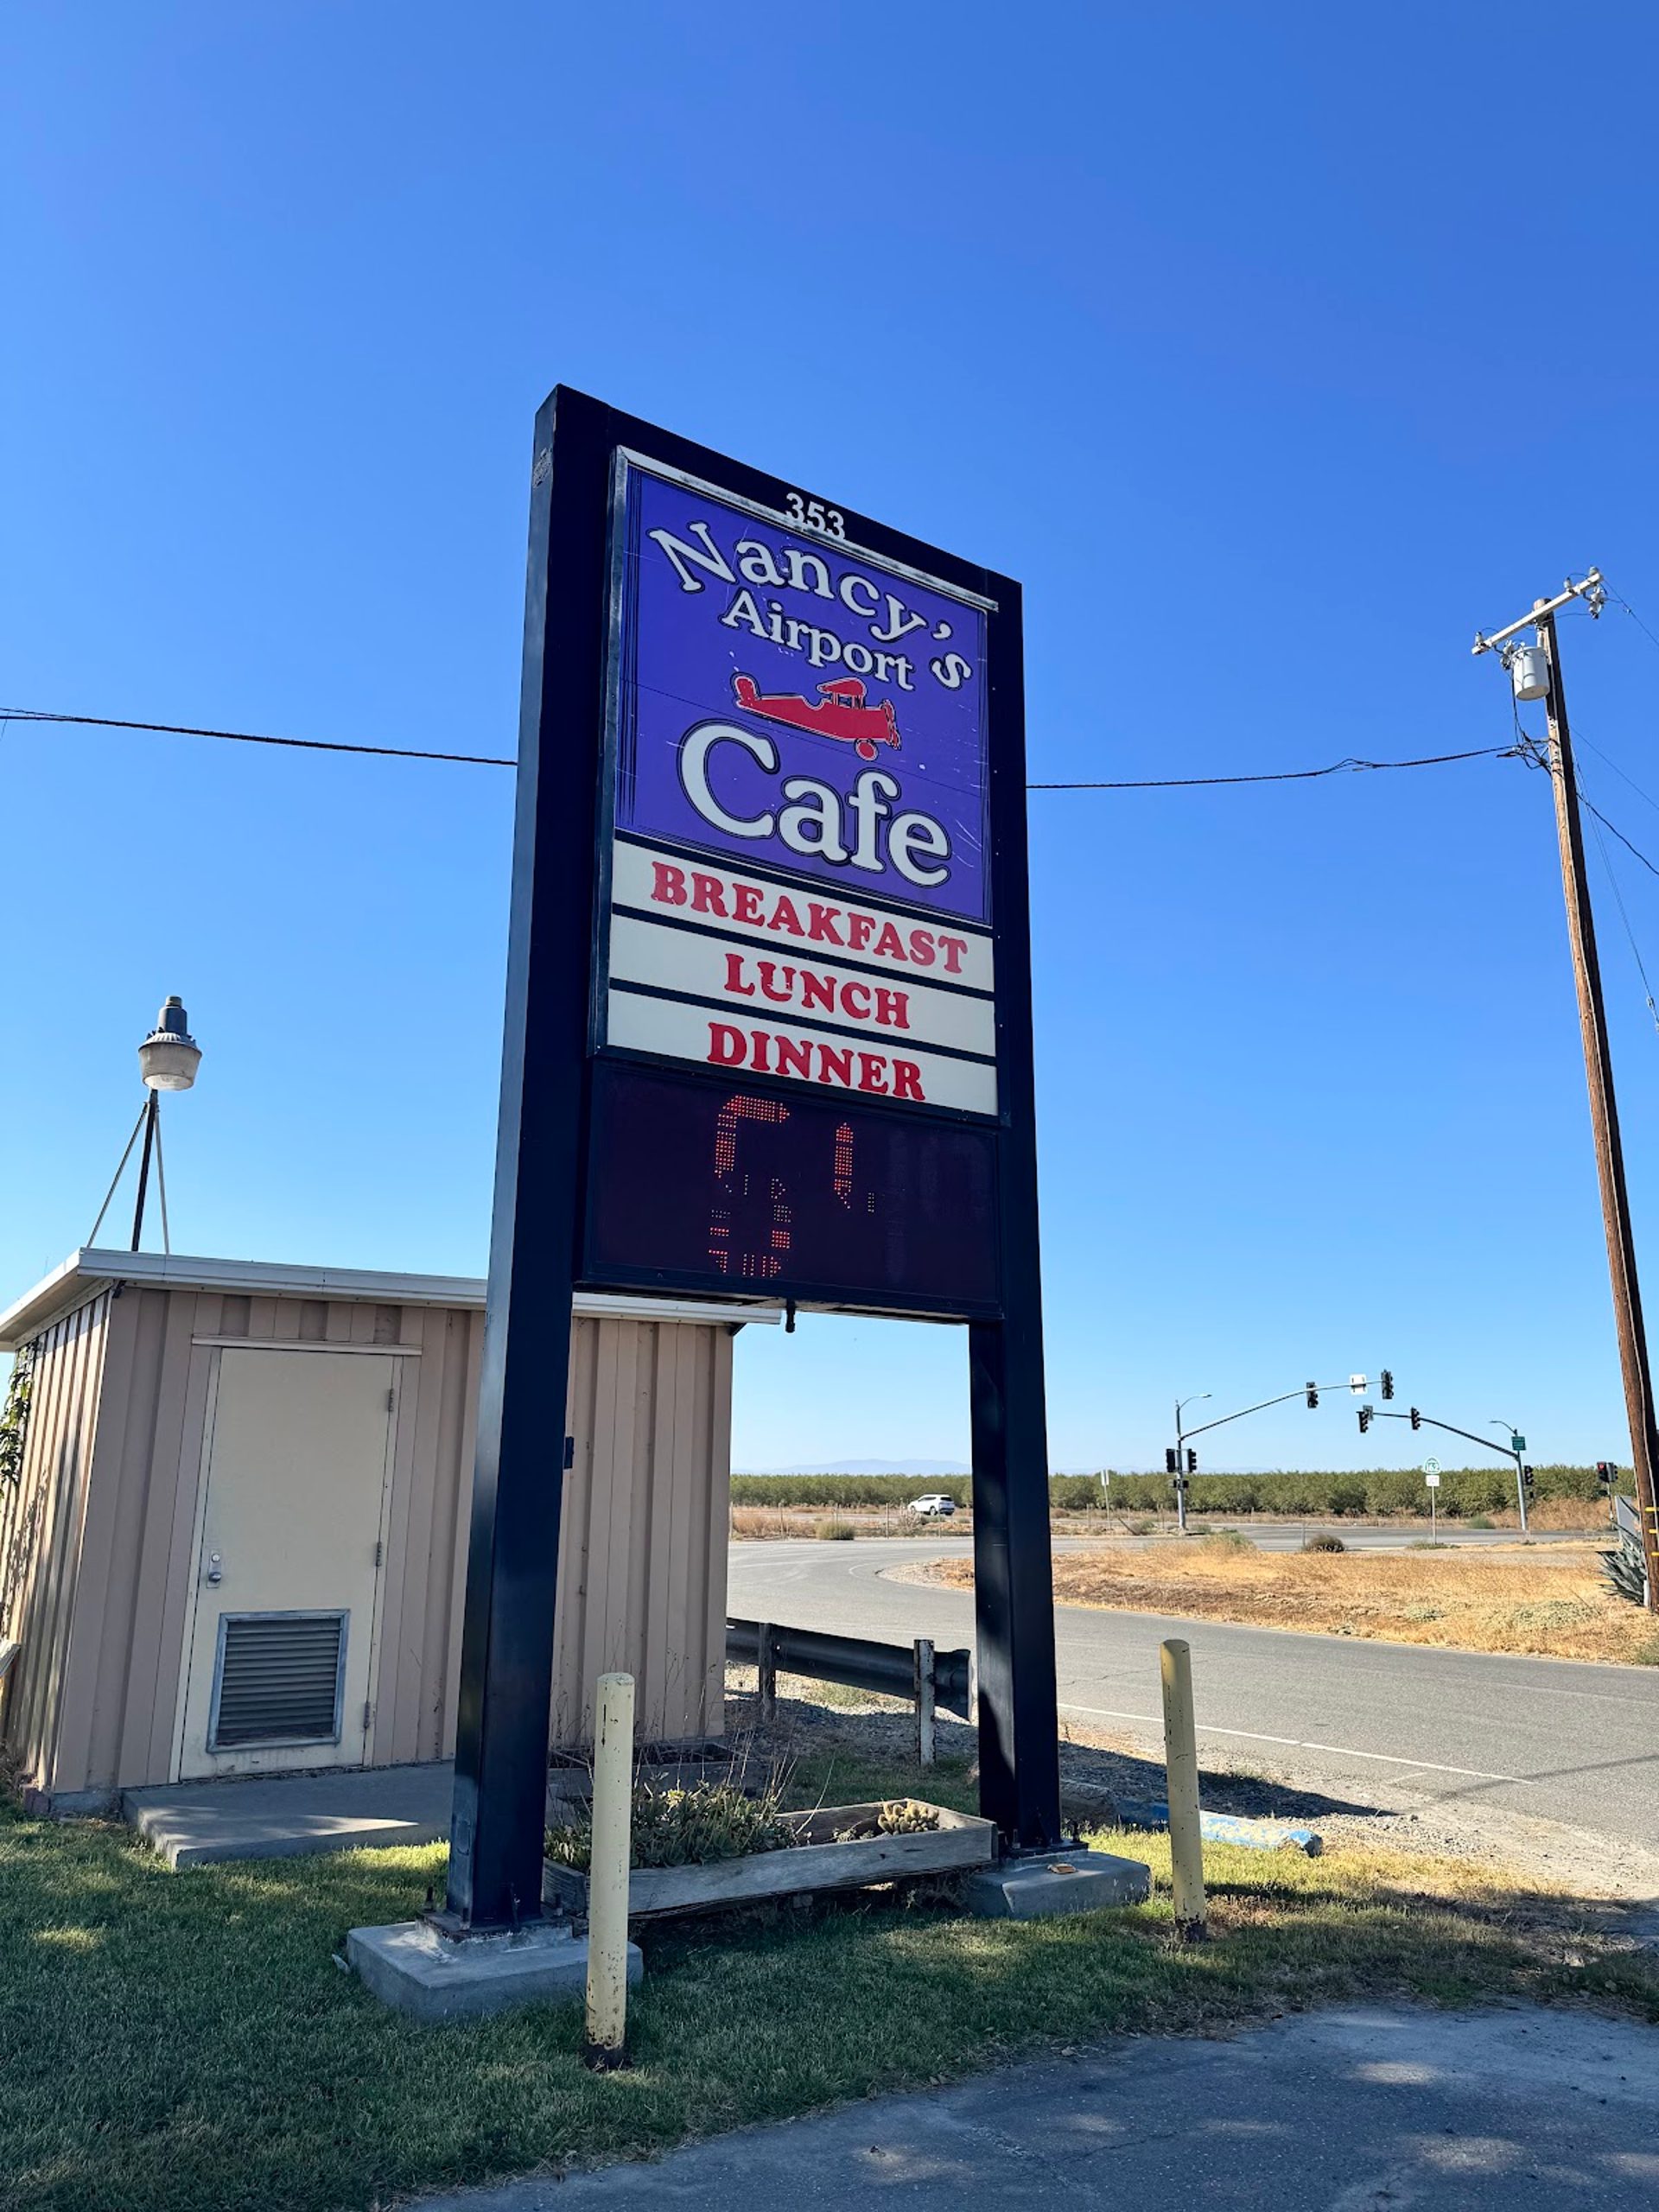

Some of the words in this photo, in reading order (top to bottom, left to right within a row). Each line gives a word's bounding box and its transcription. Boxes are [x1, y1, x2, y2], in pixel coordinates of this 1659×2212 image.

[786, 493, 846, 540] 353
[649, 522, 972, 689] Nancy's
[722, 590, 914, 690] Airport
[682, 724, 948, 887] Cafe
[652, 861, 968, 974] BREAKFAST
[724, 953, 911, 1029] LUNCH
[707, 1022, 925, 1101] DINNER
